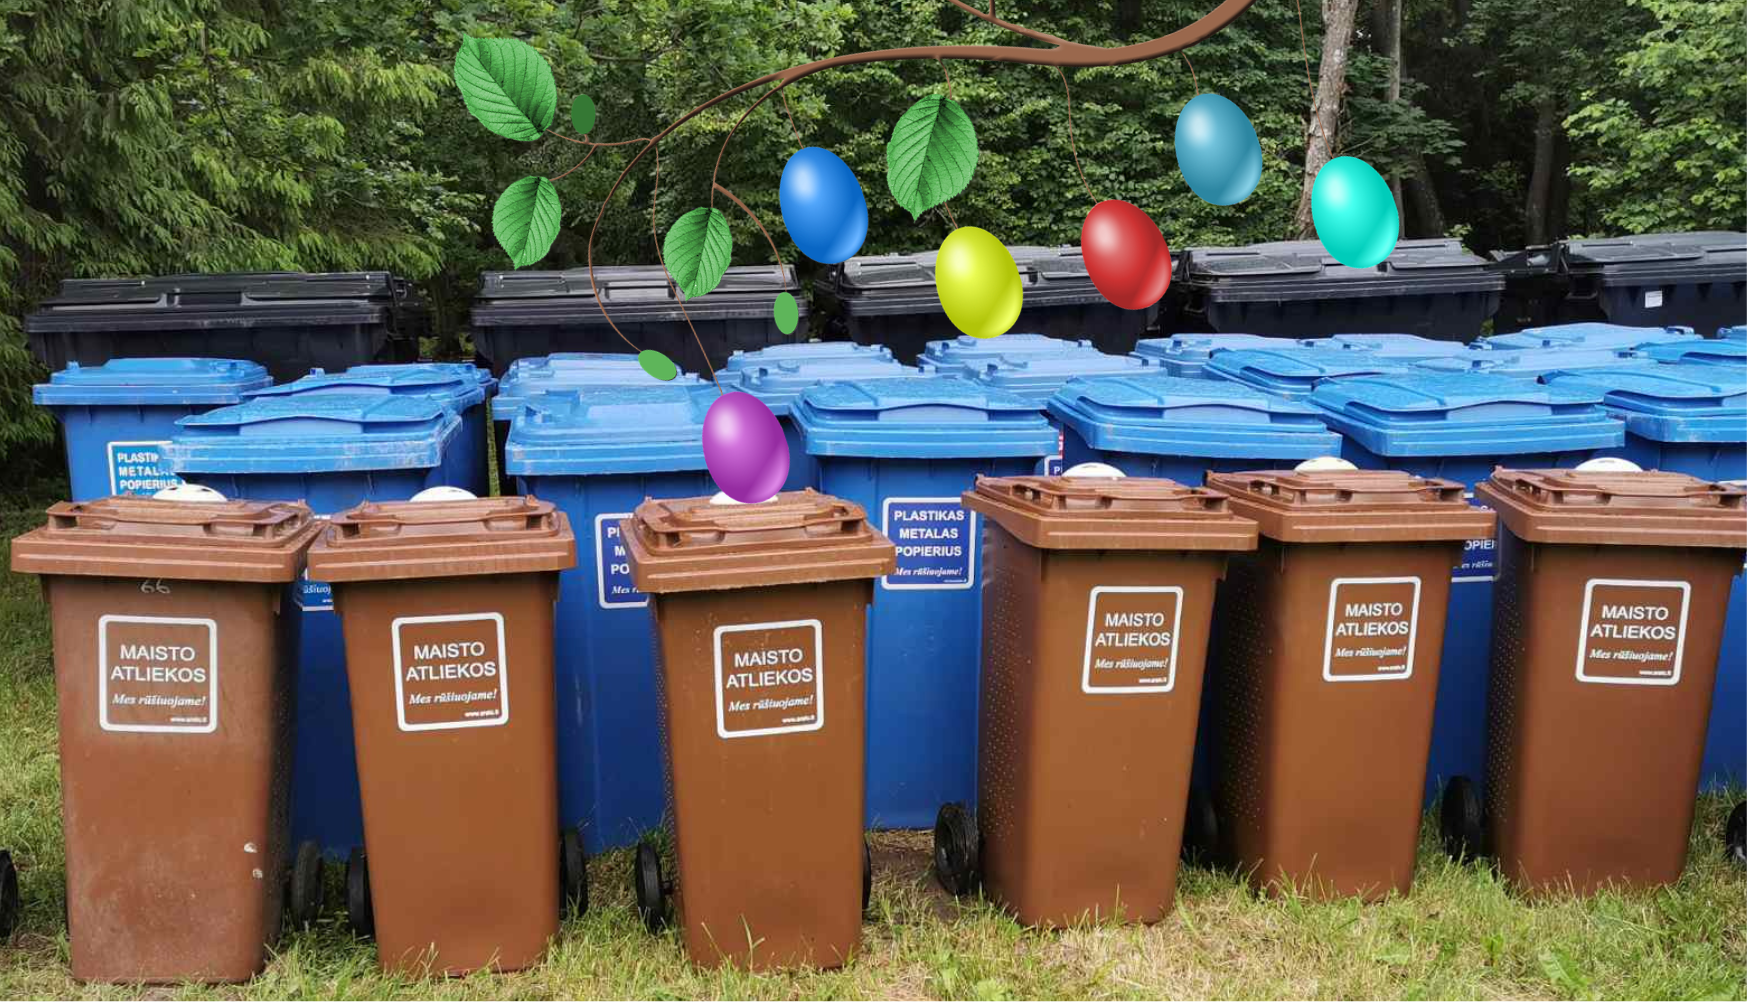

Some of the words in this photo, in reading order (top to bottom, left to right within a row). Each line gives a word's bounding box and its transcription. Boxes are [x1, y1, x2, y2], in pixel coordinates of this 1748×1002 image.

[118, 466, 164, 476] METAL
[893, 510, 965, 521] PLASTIKAS
[899, 528, 959, 539] METALAS
[895, 545, 962, 557] POPIERIUS
[140, 577, 171, 594] 66
[1345, 602, 1403, 617] MAISTO
[1601, 604, 1669, 621] MAISTO
[1105, 612, 1165, 627] MAISTO
[1335, 621, 1409, 637] ATLIEKOS
[1589, 623, 1676, 640] ATLIEKOS
[1094, 632, 1171, 647] ATLIEKOS
[120, 644, 195, 662] MAISTO
[414, 641, 485, 660] MAISTO
[734, 648, 803, 668] MAISTO
[1335, 647, 1354, 658] Mes
[1589, 648, 1611, 660] Mes
[1094, 657, 1114, 669] Mes
[111, 666, 206, 683] ATLIEKOS
[405, 661, 496, 681] ATLIEKOS
[726, 667, 813, 689] ATLIEKOS
[112, 693, 136, 705] Mes
[409, 693, 431, 705] Mes
[728, 700, 750, 712] Mes
